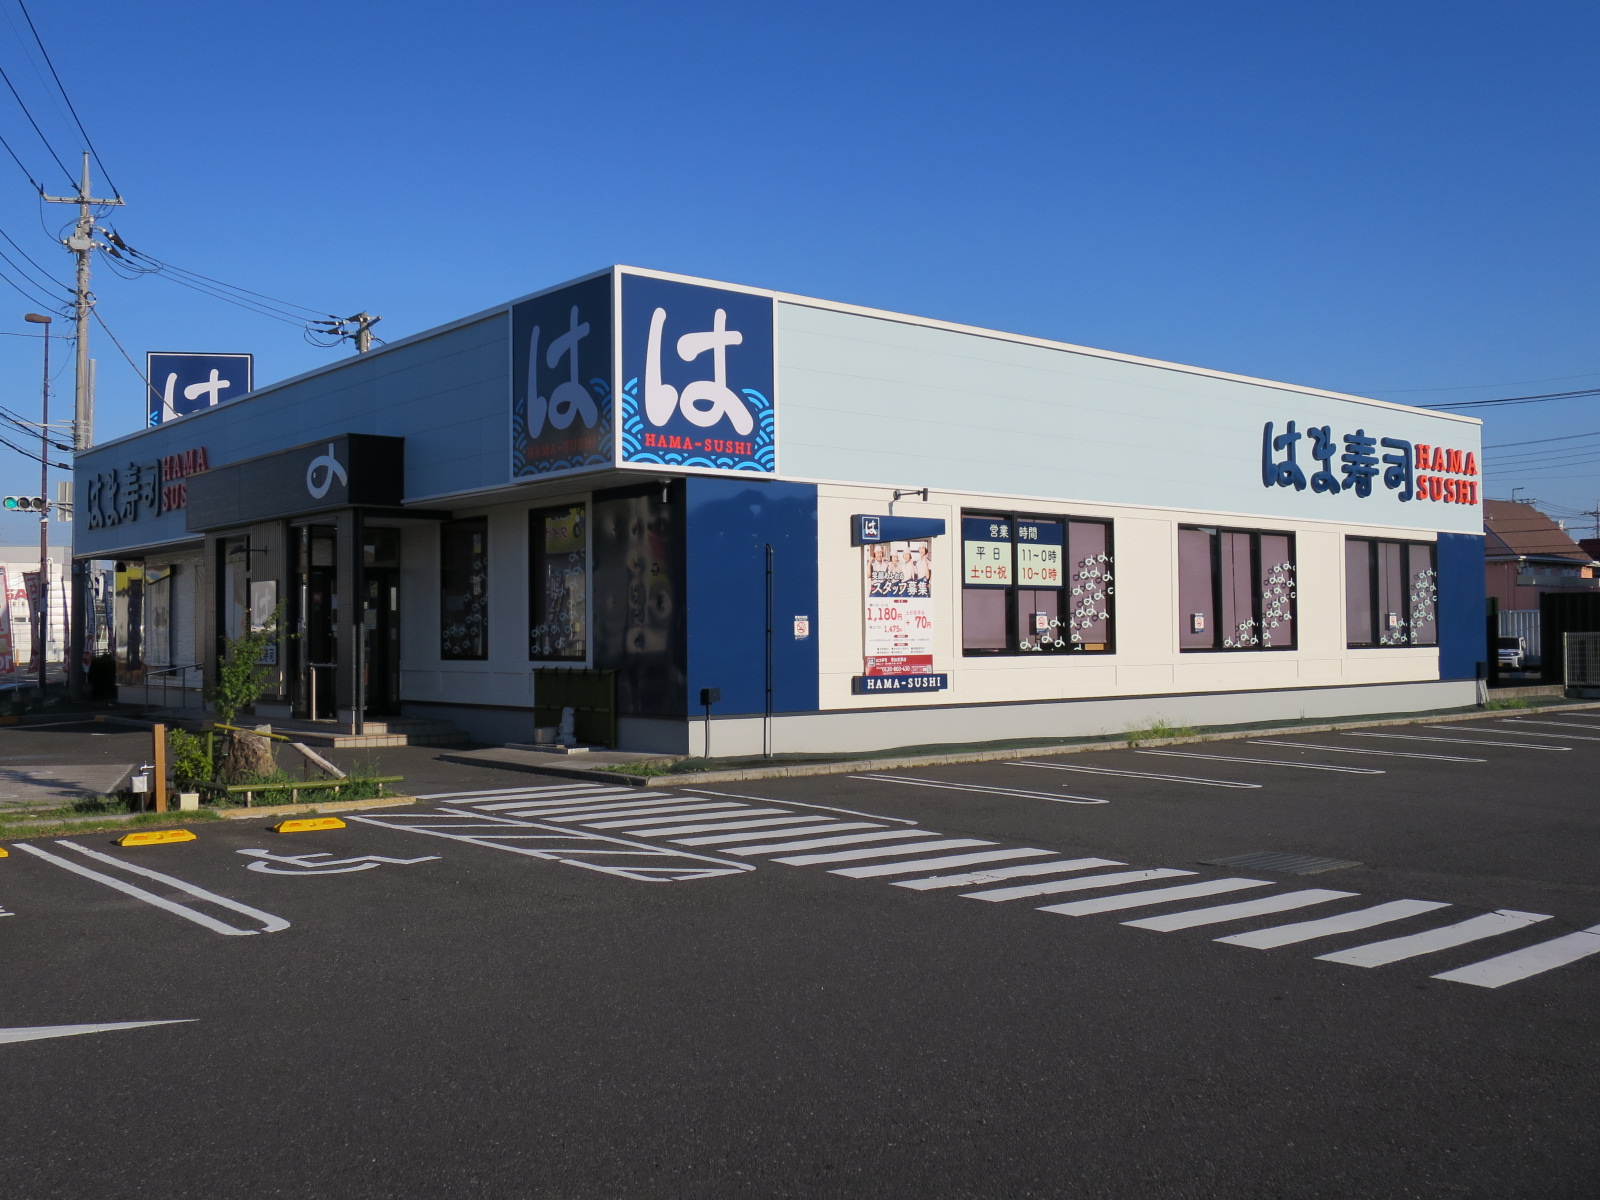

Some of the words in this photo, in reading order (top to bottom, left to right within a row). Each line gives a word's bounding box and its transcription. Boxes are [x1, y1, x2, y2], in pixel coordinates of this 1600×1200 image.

[527, 304, 598, 438] は
[644, 307, 754, 436] は
[644, 433, 752, 455] HAMA-SUSHI
[1414, 443, 1478, 476] HAMA
[162, 446, 209, 482] HAMA
[1261, 420, 1413, 502] はま寿司
[88, 458, 162, 530] はま寿司
[1416, 474, 1478, 505] SUSHI
[865, 520, 877, 535] は
[872, 581, 928, 596] スタッフ募集
[867, 607, 902, 622] 1,180円
[915, 616, 931, 629] 70円
[867, 677, 941, 689] HAMA-SUSHI
